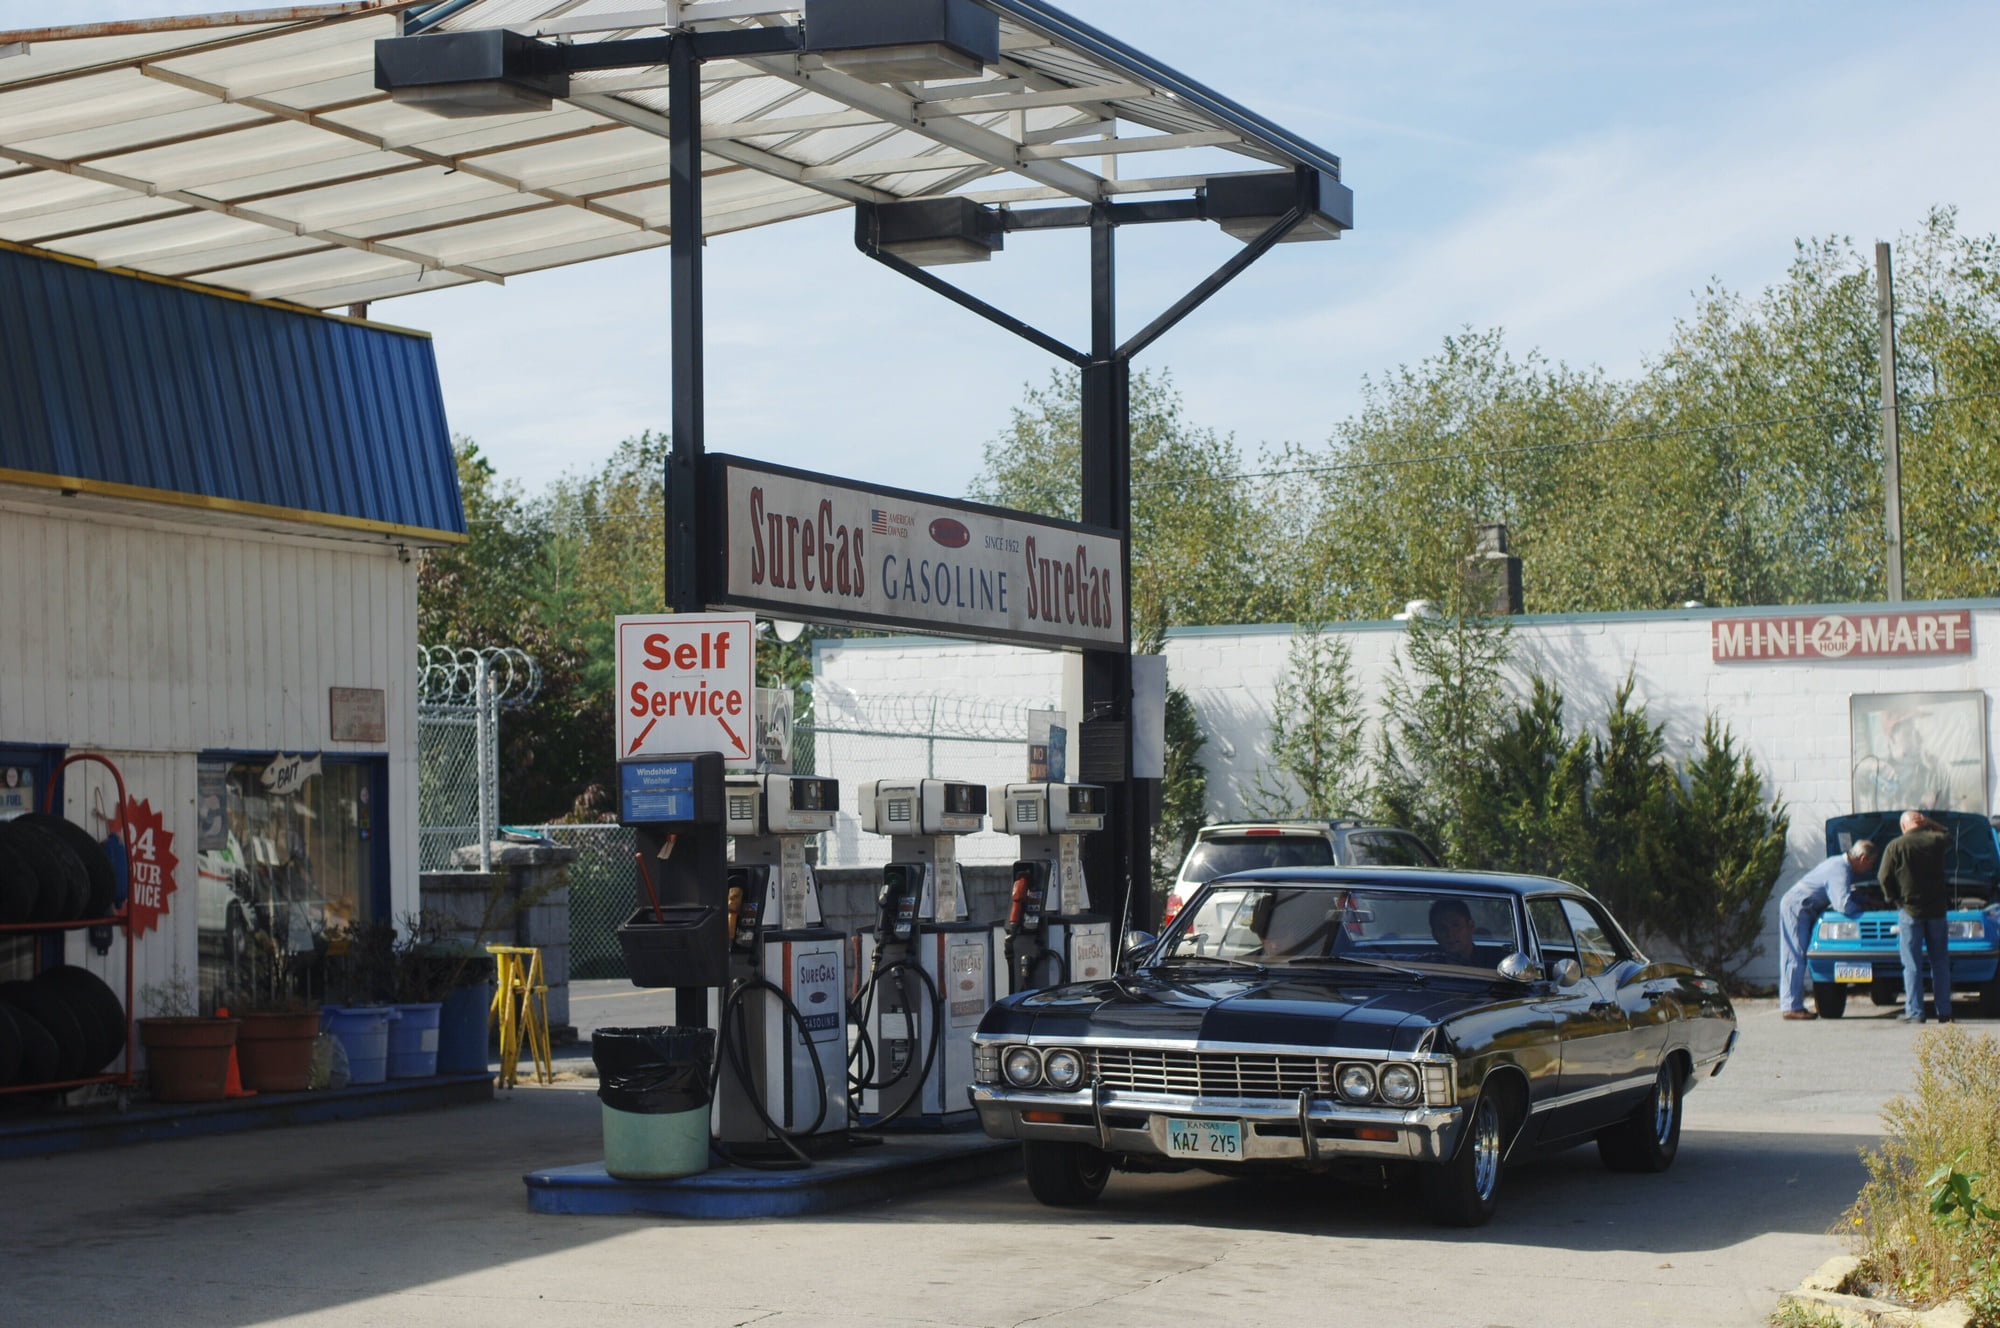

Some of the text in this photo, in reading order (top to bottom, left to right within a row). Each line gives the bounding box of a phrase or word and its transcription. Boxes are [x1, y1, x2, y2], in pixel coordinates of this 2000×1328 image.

[889, 513, 915, 527] AMERICAN
[750, 486, 865, 598] SureGas
[984, 535, 1004, 551] SINCE
[882, 554, 1008, 613] GASOLINE
[1025, 535, 1112, 630] SureGas
[1718, 615, 1961, 657] MINI MART
[1818, 620, 1850, 641] 24
[642, 631, 730, 671] Self
[1819, 641, 1849, 652] HOUR
[630, 681, 742, 717] Service
[277, 760, 300, 789] BAIT
[636, 767, 678, 776] Windshield
[643, 776, 671, 785] Washer
[1187, 1121, 1220, 1130] KANSAS
[1173, 1132, 1236, 1153] KAZ 2Y5
